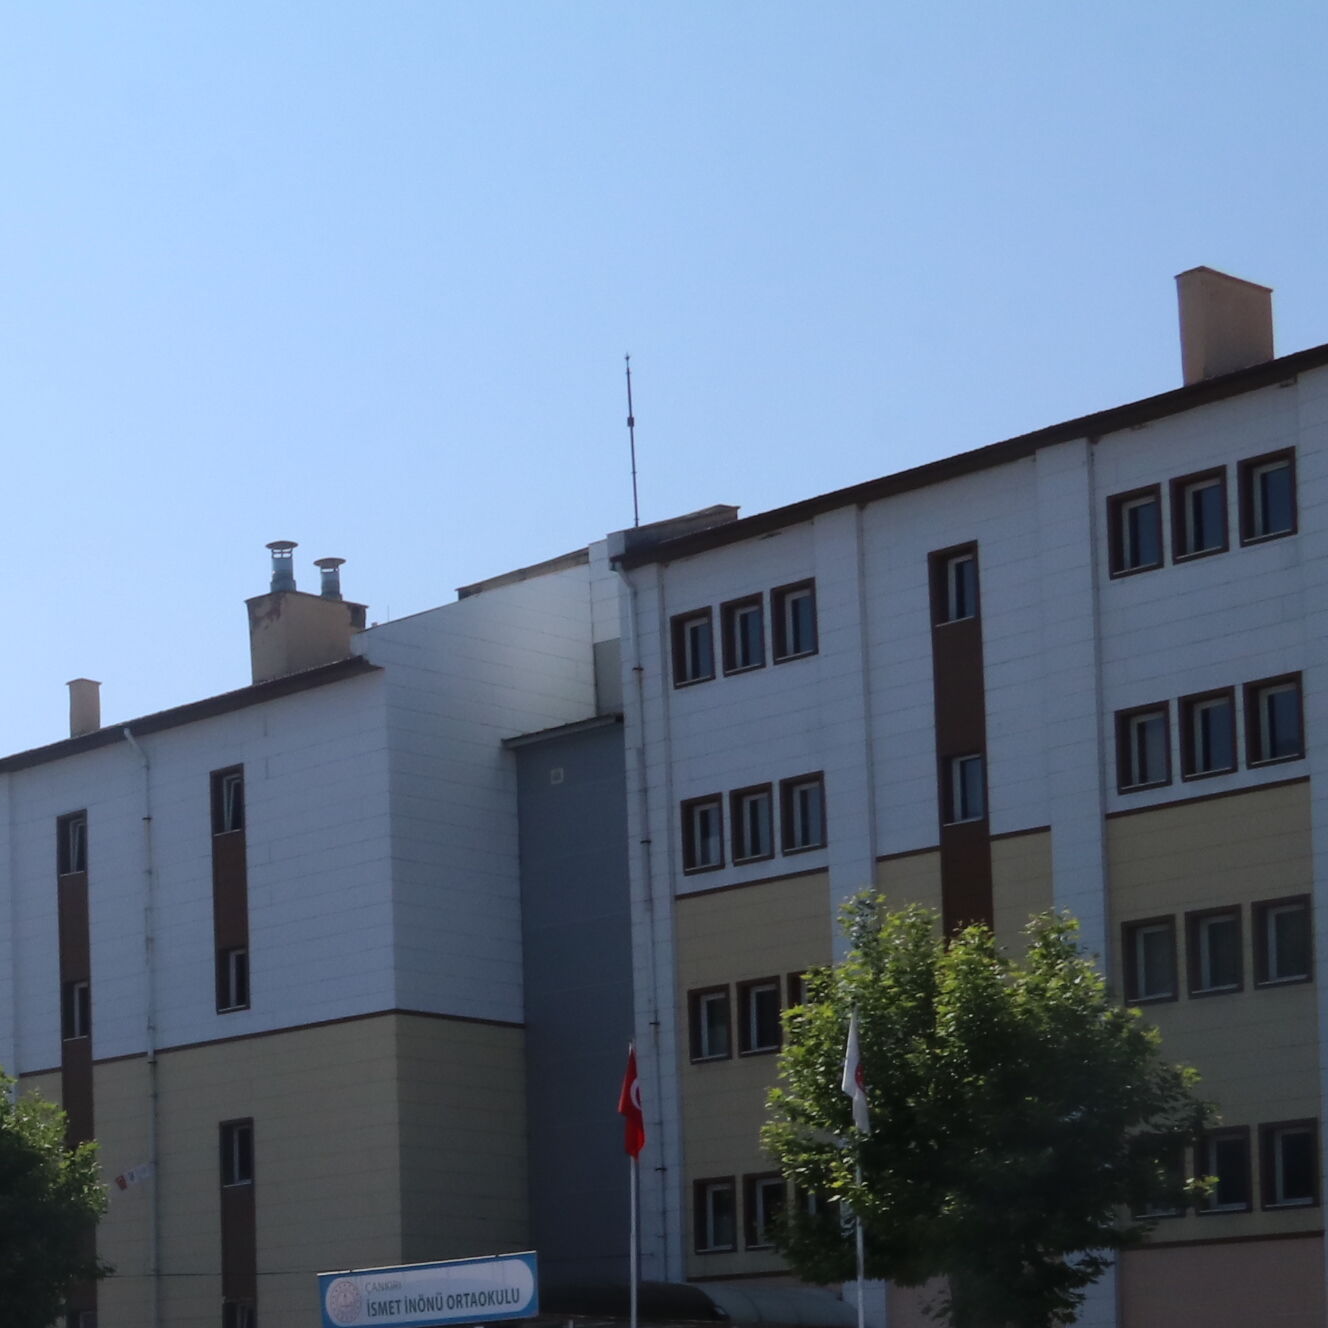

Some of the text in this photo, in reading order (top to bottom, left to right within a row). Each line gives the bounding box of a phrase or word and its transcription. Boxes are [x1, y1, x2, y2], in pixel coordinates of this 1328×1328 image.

[367, 1287, 520, 1317] İSMET İNÖNÜ ORTAOKULU
